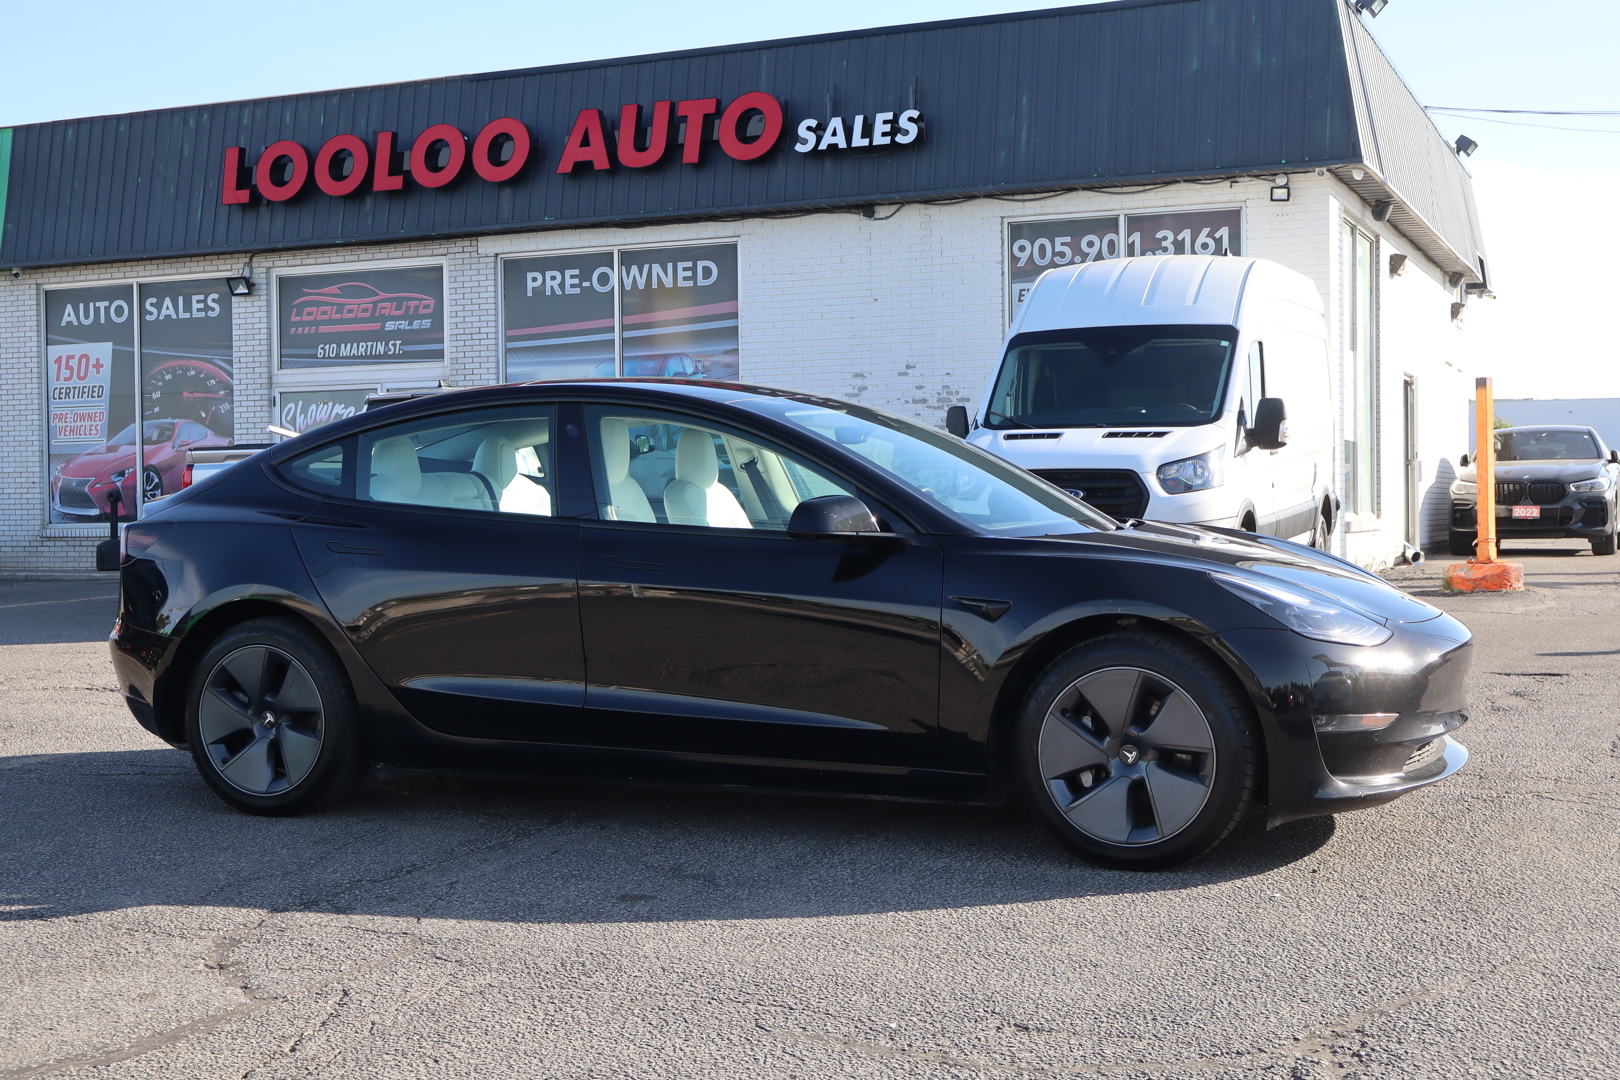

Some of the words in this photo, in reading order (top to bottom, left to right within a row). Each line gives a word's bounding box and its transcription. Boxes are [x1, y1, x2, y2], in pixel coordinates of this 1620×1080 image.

[221, 118, 531, 205] LOOLOO
[556, 91, 783, 174] AUTO
[794, 109, 921, 153] SALES
[1012, 226, 1229, 266] 905.901.3161
[526, 260, 719, 297] PRE-OWNED
[61, 299, 129, 327] AUTO
[145, 293, 220, 321] SALES
[290, 303, 374, 322] LOOLOO
[375, 300, 435, 317] AUTO
[384, 319, 432, 331] SALES
[317, 343, 337, 358] 610
[339, 341, 386, 357] MARTIN
[387, 340, 403, 355] ST.
[53, 353, 104, 383] 150+
[52, 384, 105, 401] CERTIFIED
[152, 391, 161, 399] 50
[219, 402, 231, 413] 210
[52, 410, 105, 424] PRE-OWNED
[57, 423, 100, 438] VEHICLES
[1514, 508, 1538, 517] 2022
